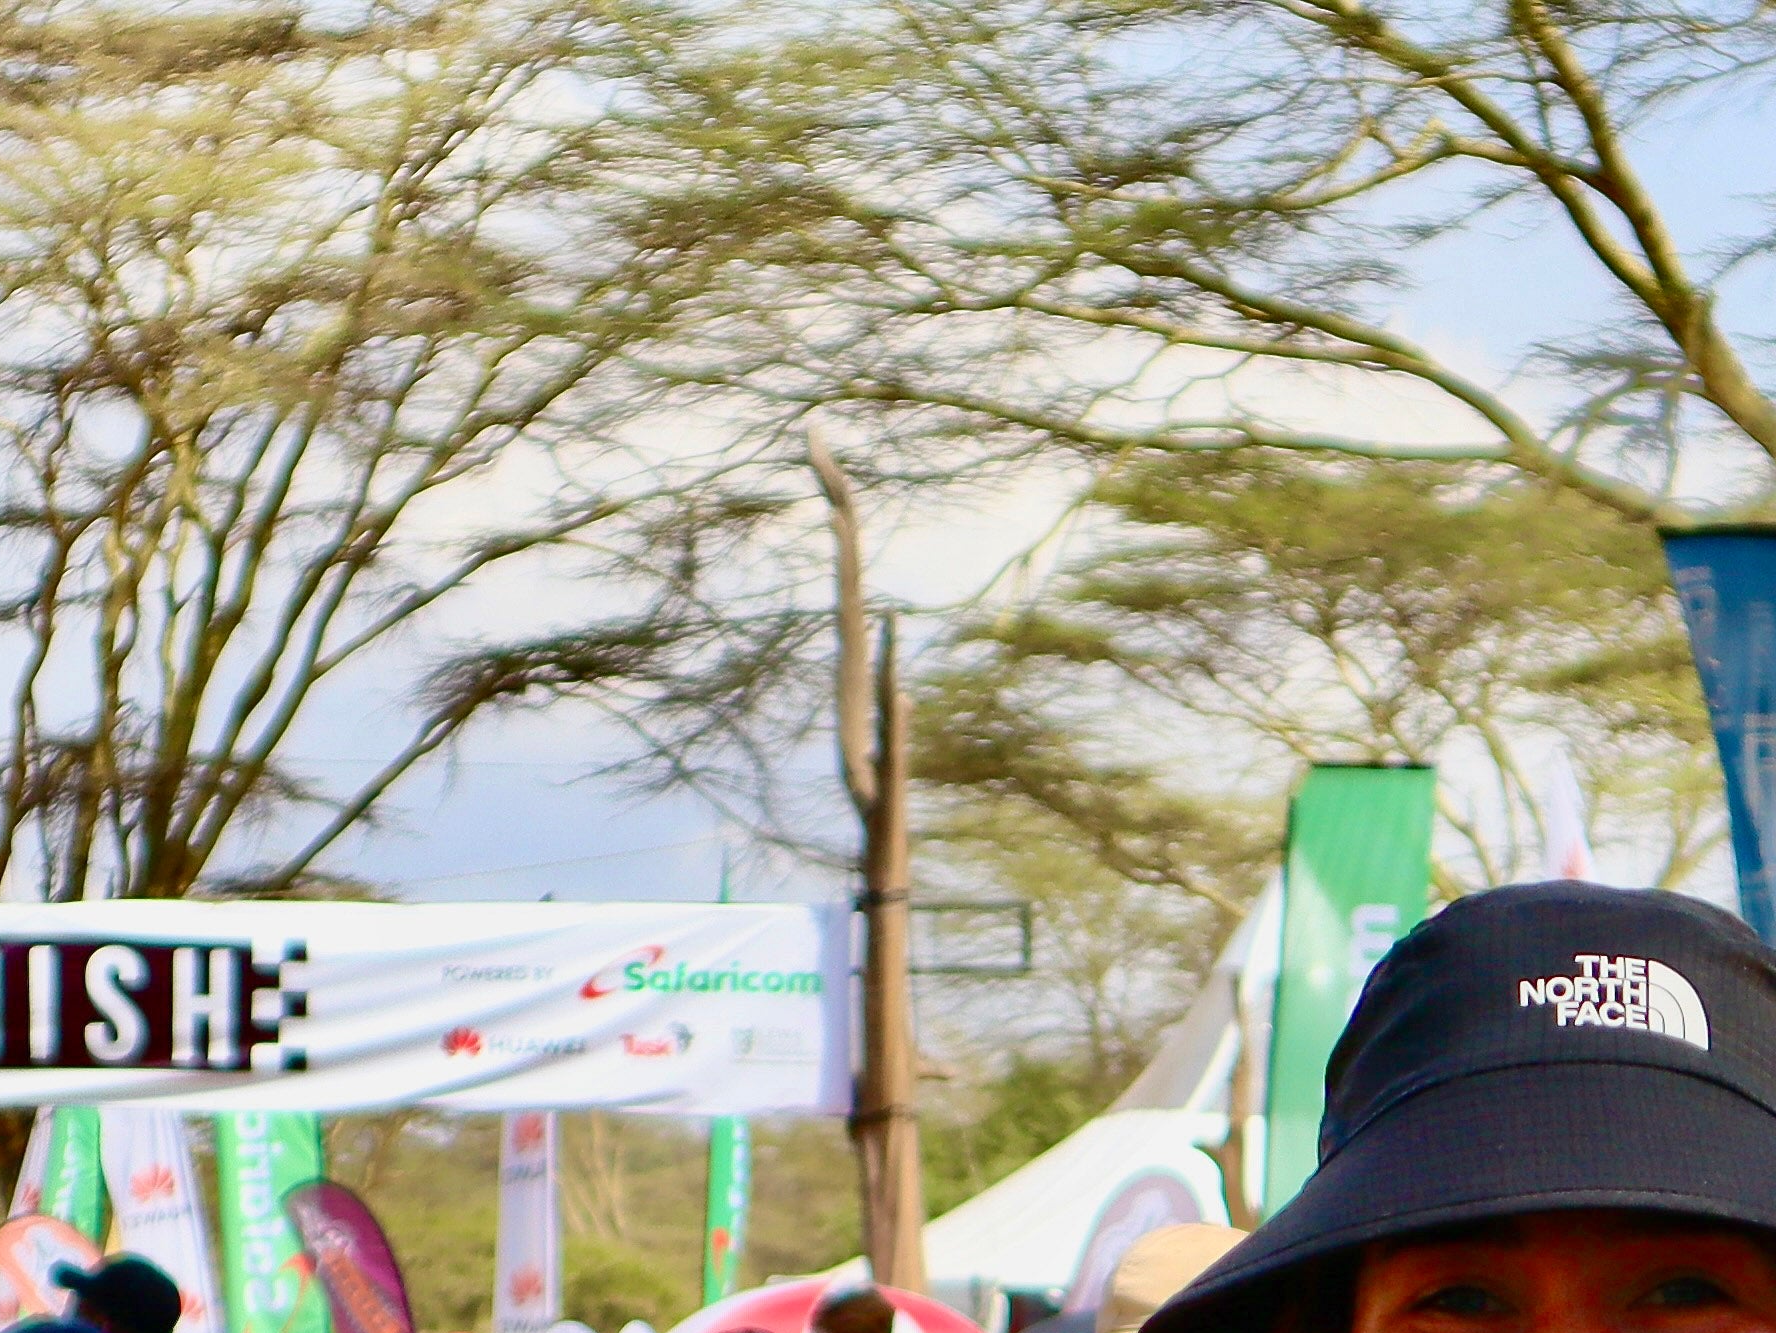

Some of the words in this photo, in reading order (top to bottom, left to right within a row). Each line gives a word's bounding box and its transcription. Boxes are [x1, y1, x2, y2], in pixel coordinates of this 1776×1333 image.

[623, 957, 822, 996] Safaricom
[1574, 955, 1647, 979] THE
[1519, 975, 1648, 1006] NORTH
[1556, 1000, 1648, 1030] FACE
